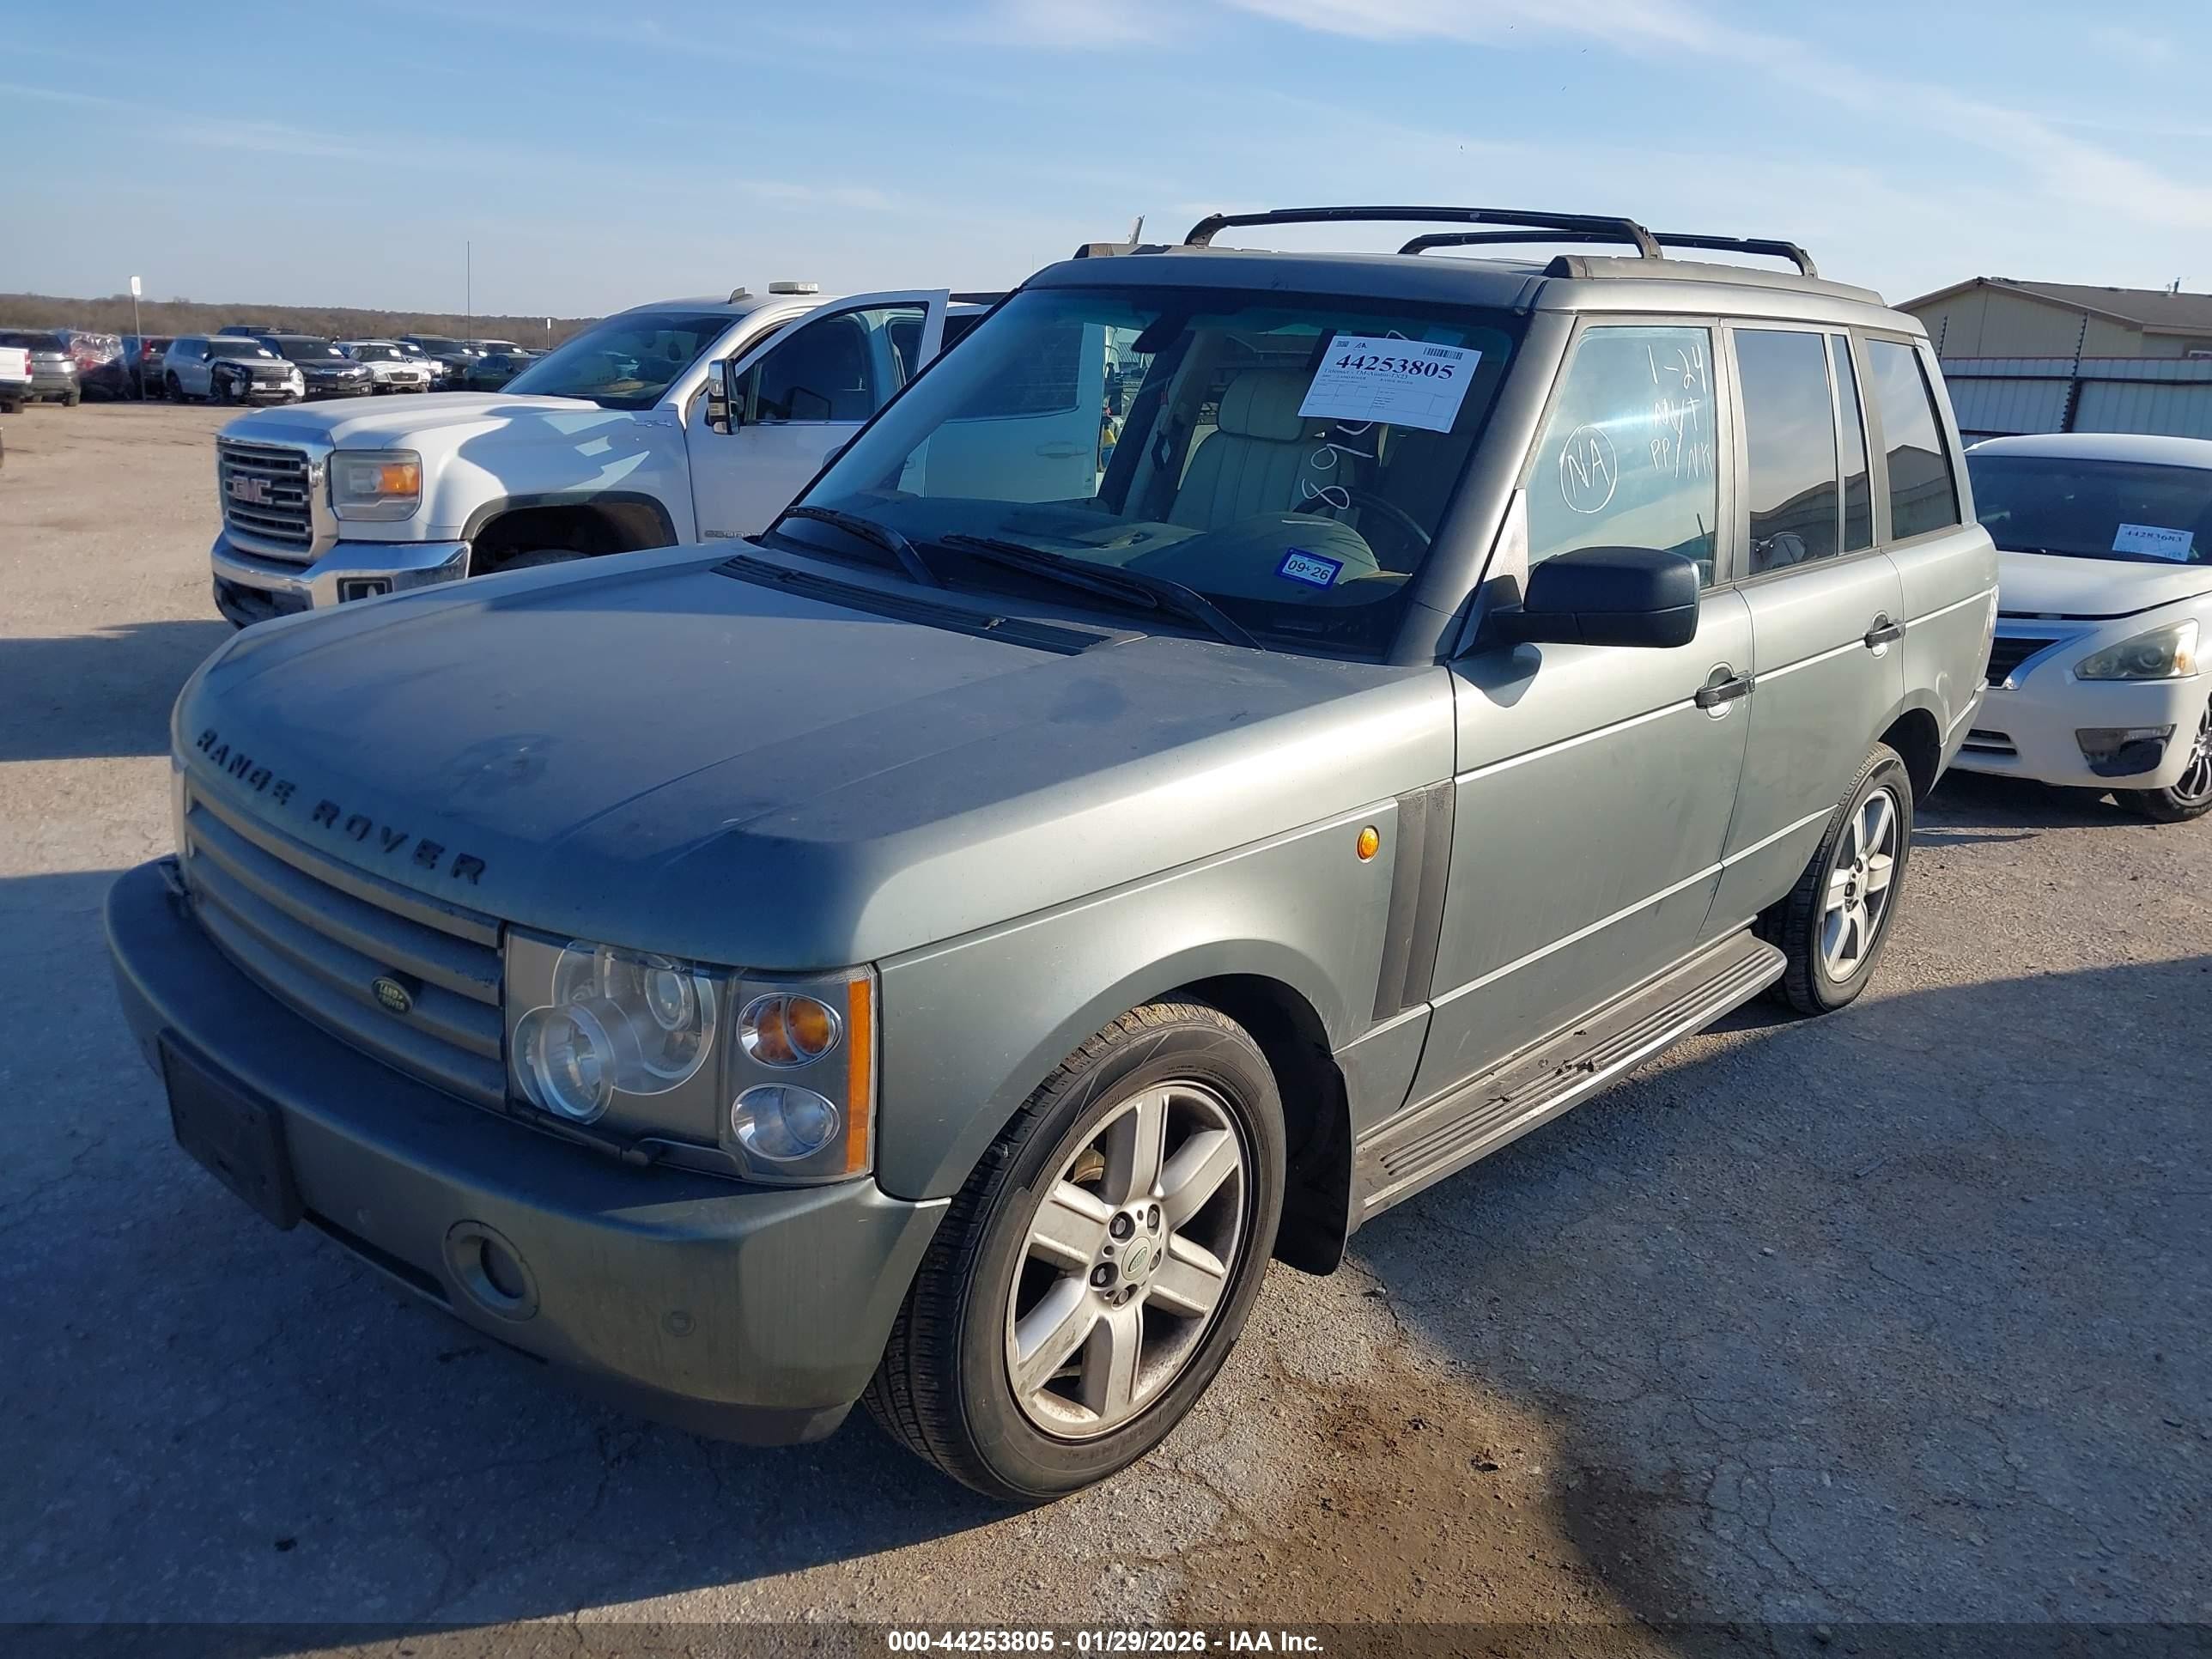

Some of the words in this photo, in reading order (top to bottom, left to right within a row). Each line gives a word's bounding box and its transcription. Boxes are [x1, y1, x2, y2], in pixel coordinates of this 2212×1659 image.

[1335, 354, 1456, 380] 44253805
[231, 476, 273, 505] GMC
[196, 727, 296, 806] RANGE
[311, 798, 487, 886] ROVER
